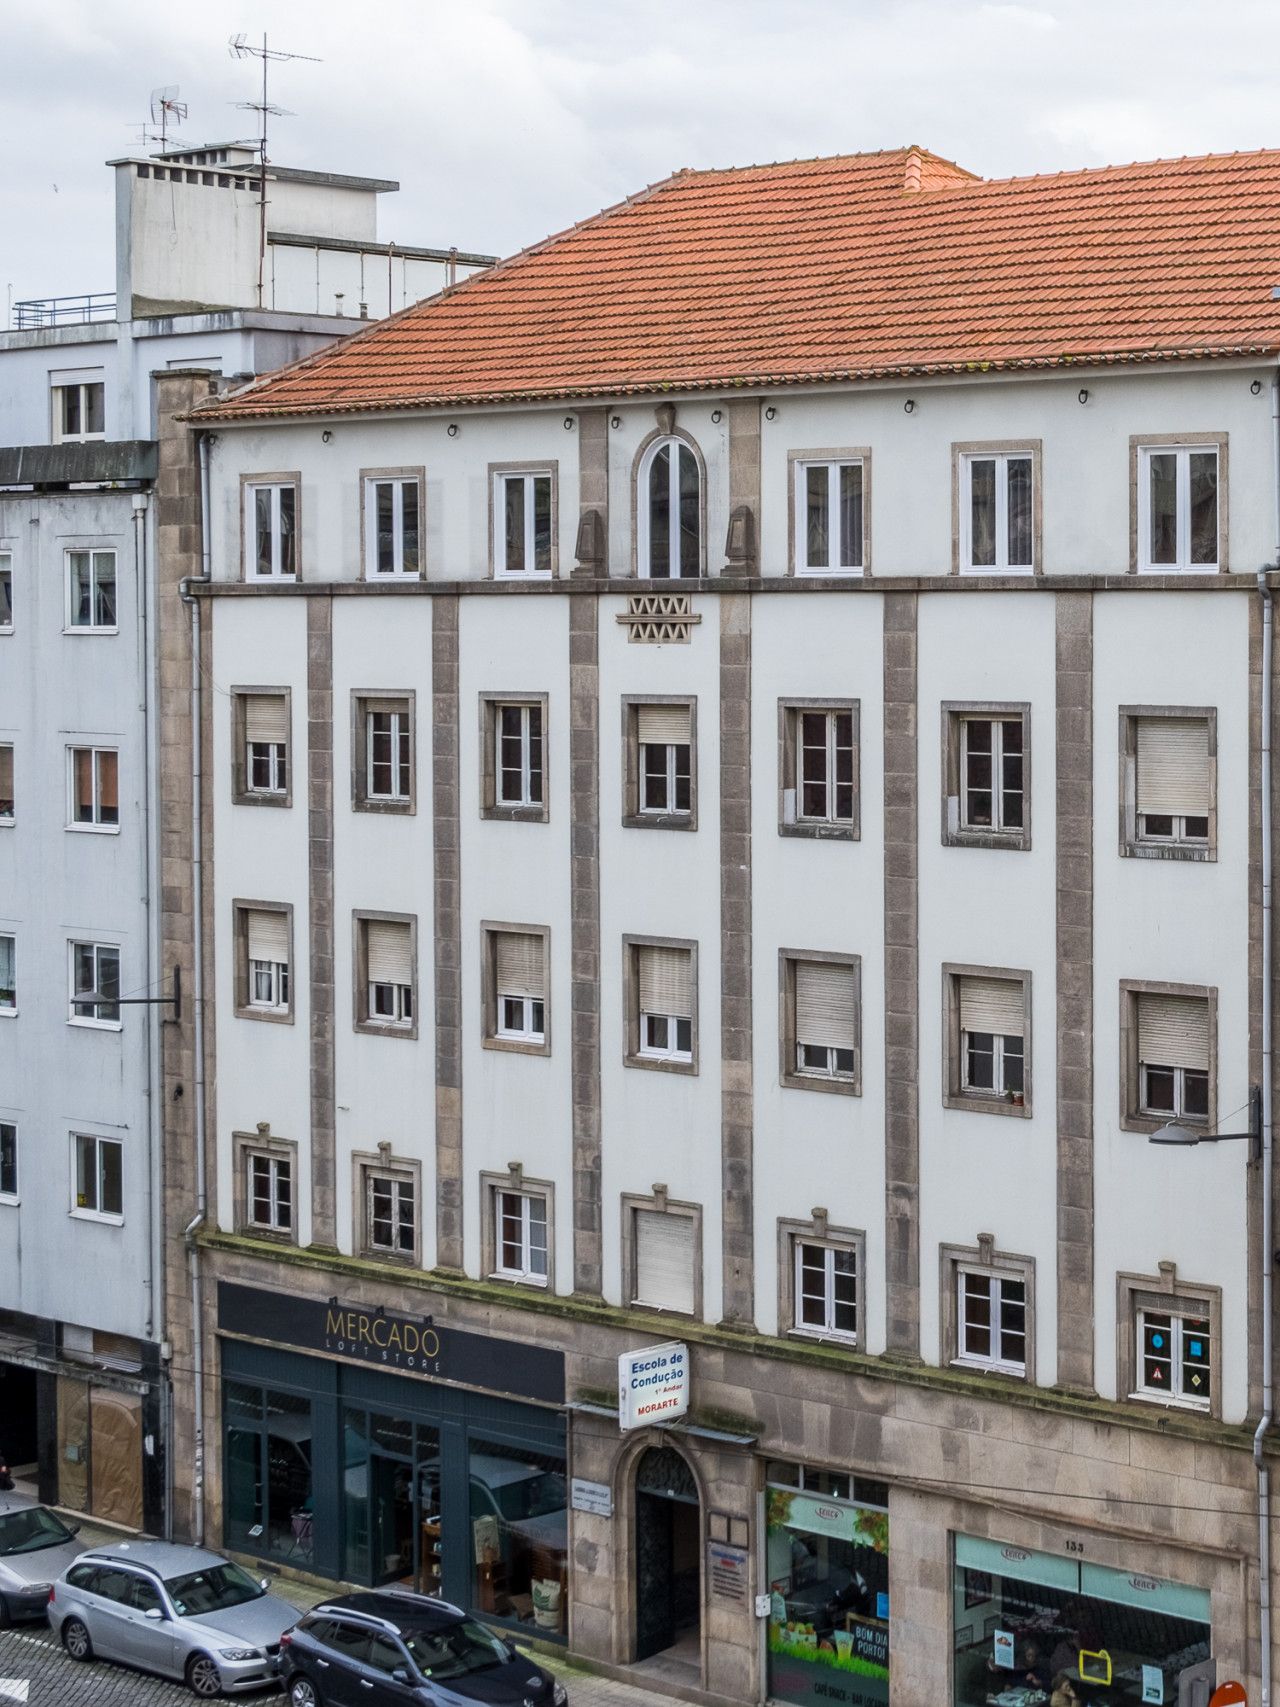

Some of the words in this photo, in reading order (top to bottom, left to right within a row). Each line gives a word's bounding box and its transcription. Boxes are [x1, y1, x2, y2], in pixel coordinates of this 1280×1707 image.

[326, 1309, 440, 1357] MERCADO
[326, 1339, 369, 1356] LOFT
[382, 1350, 440, 1372] STORE
[632, 1357, 667, 1374] Escola
[670, 1353, 683, 1364] de
[631, 1369, 684, 1389] Condução
[663, 1384, 683, 1393] Andar
[637, 1398, 679, 1415] MORARTE
[855, 1626, 873, 1642] BOM
[875, 1632, 888, 1646] DIA
